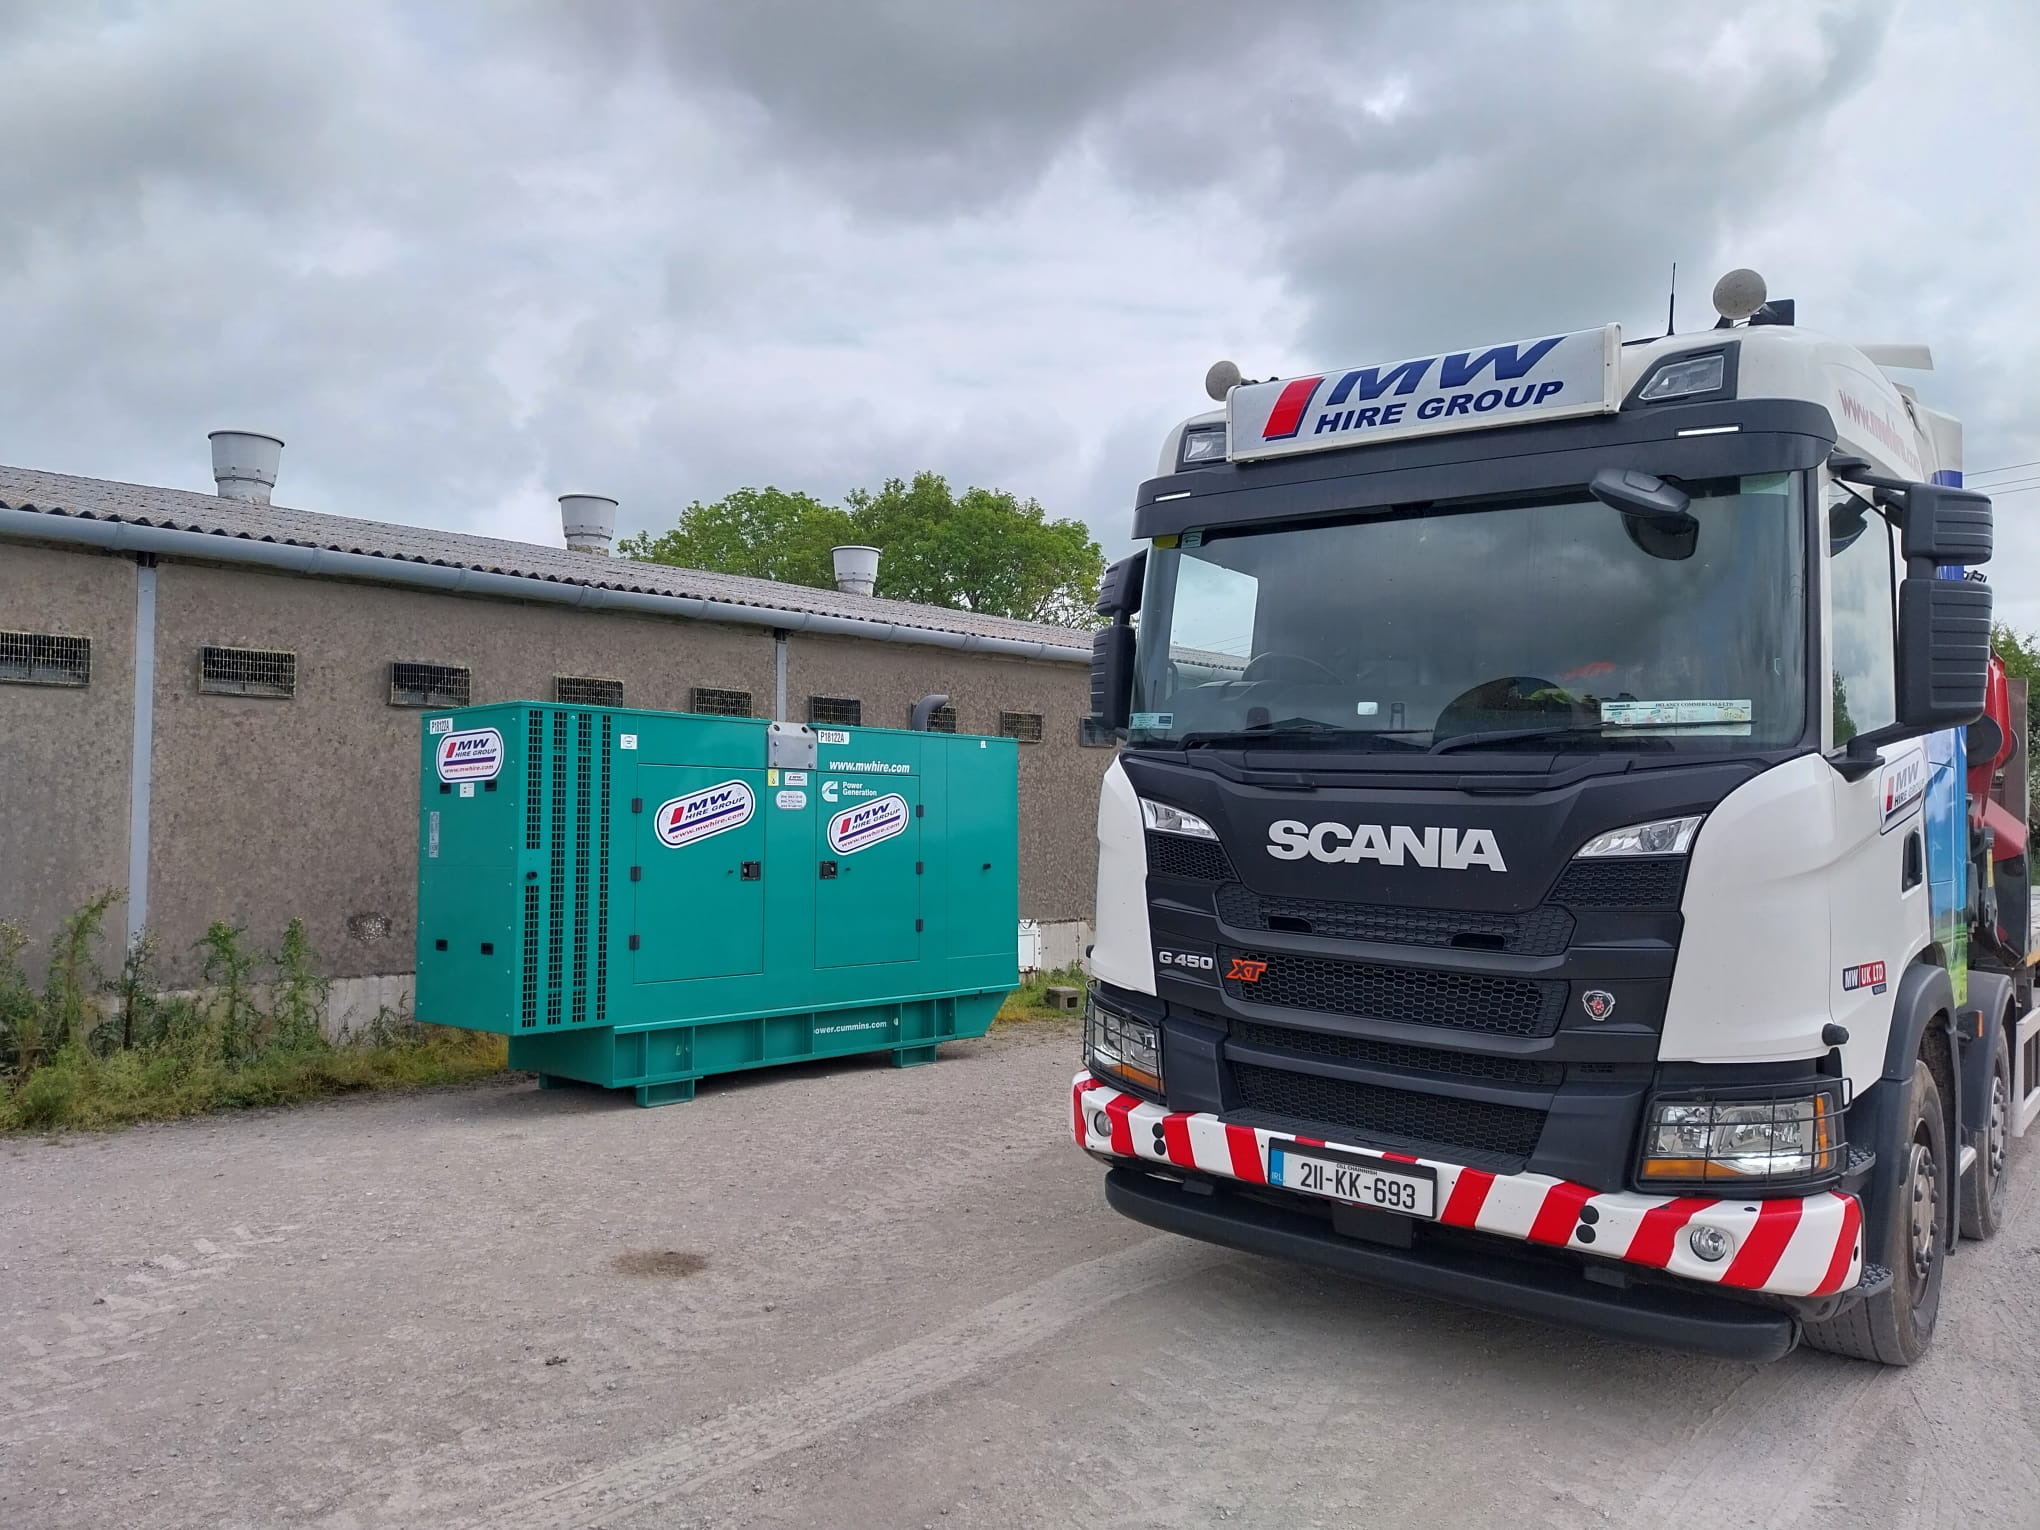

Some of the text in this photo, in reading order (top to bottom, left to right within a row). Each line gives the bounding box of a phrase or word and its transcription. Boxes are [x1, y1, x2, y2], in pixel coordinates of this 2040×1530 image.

[1325, 335, 1569, 407] MW
[1313, 380, 1565, 435] HIRE GROUP
[454, 748, 497, 758] HIRE GROUP
[457, 738, 490, 751] MW
[829, 760, 910, 773] www.mwhire.com
[1895, 760, 1920, 792] MW
[842, 781, 863, 789] Power
[842, 788, 878, 796] Generation
[685, 796, 745, 820] HIRE GROUP
[686, 790, 733, 813] MW
[1894, 790, 1908, 807] HIRE
[851, 808, 901, 831] HIRE GROUP
[853, 803, 891, 824] MW
[671, 811, 745, 840] www.mwhire.com
[1266, 819, 1508, 872] SCANIA
[1158, 951, 1214, 970] G 450
[1225, 958, 1268, 982] XT
[1844, 968, 1859, 989] MW
[1861, 966, 1872, 985] UK
[1872, 963, 1884, 982] LTD
[814, 1020, 887, 1034] ower.cummins.com
[1271, 1171, 1283, 1182] IRL
[1300, 1162, 1416, 1210] 211-KK-693
